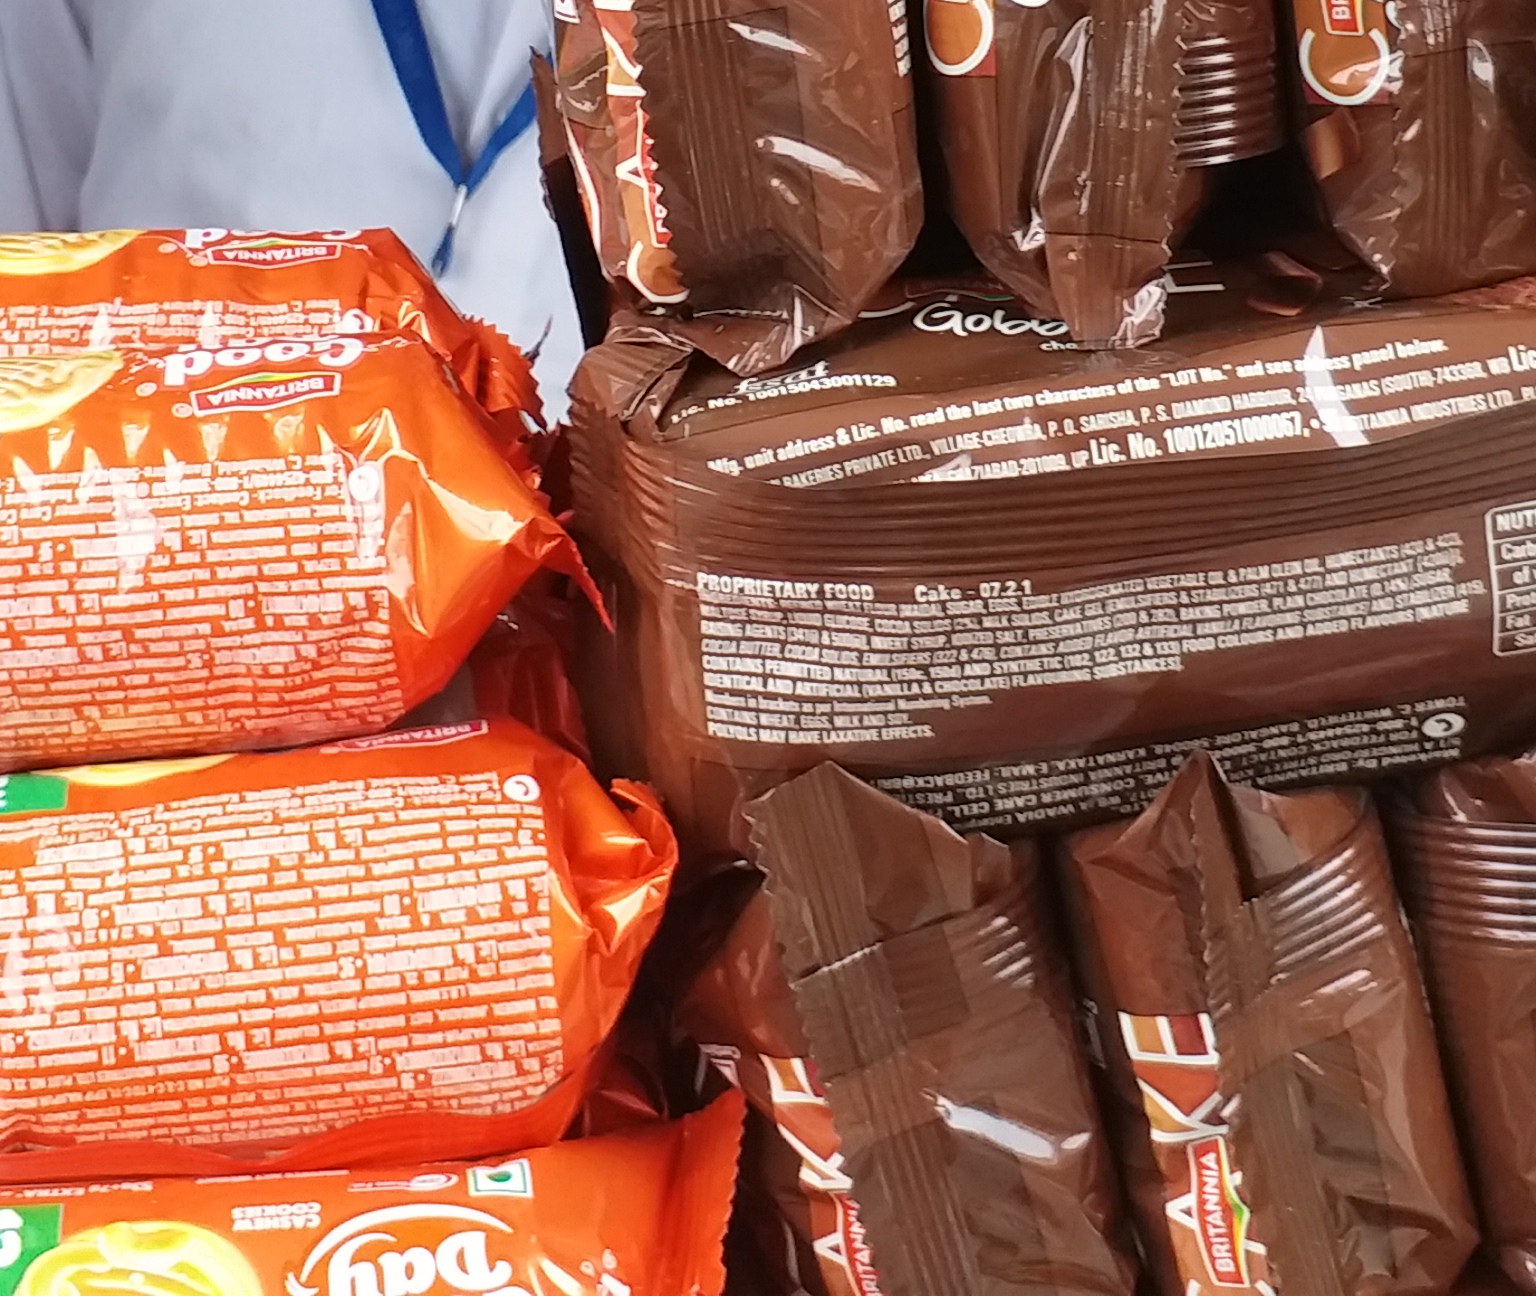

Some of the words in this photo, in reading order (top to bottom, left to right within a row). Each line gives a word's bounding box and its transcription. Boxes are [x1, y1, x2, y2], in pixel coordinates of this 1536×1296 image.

[222, 245, 327, 262] BRITANNIA
[164, 336, 363, 387] Good
[207, 375, 325, 405] BRITANNIA
[745, 447, 777, 468] unit
[777, 438, 836, 463] address
[836, 428, 851, 445] &
[853, 420, 881, 442] Lic.
[882, 416, 910, 434] No.
[910, 407, 946, 428] read
[948, 403, 972, 422] the
[973, 398, 1002, 417] last
[1003, 394, 1034, 411] two
[1035, 383, 1115, 406] characters
[1117, 379, 1134, 394] of
[1136, 376, 1161, 392] the
[1236, 360, 1265, 377] and
[1266, 360, 1293, 374] see
[1352, 344, 1395, 371] panel
[1395, 333, 1449, 358] below.
[708, 397, 743, 410] No.
[1089, 437, 1127, 466] Lic.
[1128, 431, 1163, 459] No.
[696, 571, 820, 599] PROPRIETARY
[823, 583, 875, 601] FOOD
[1513, 565, 1531, 586] of
[914, 584, 963, 603] Cake
[979, 578, 1033, 598] 07.2.1
[1505, 614, 1532, 630] Fat
[1087, 756, 1168, 781] BRITANNIA
[997, 770, 1085, 793] INDUSTRIES
[1040, 777, 1135, 804] CONSUMER
[994, 793, 1038, 813] CARE
[1015, 800, 1076, 825] WADIA
[229, 1201, 322, 1221] COOKIES
[229, 1214, 321, 1233] CASHEW
[1199, 1150, 1235, 1274] BRITANNIA
[323, 1230, 514, 1296] Day
